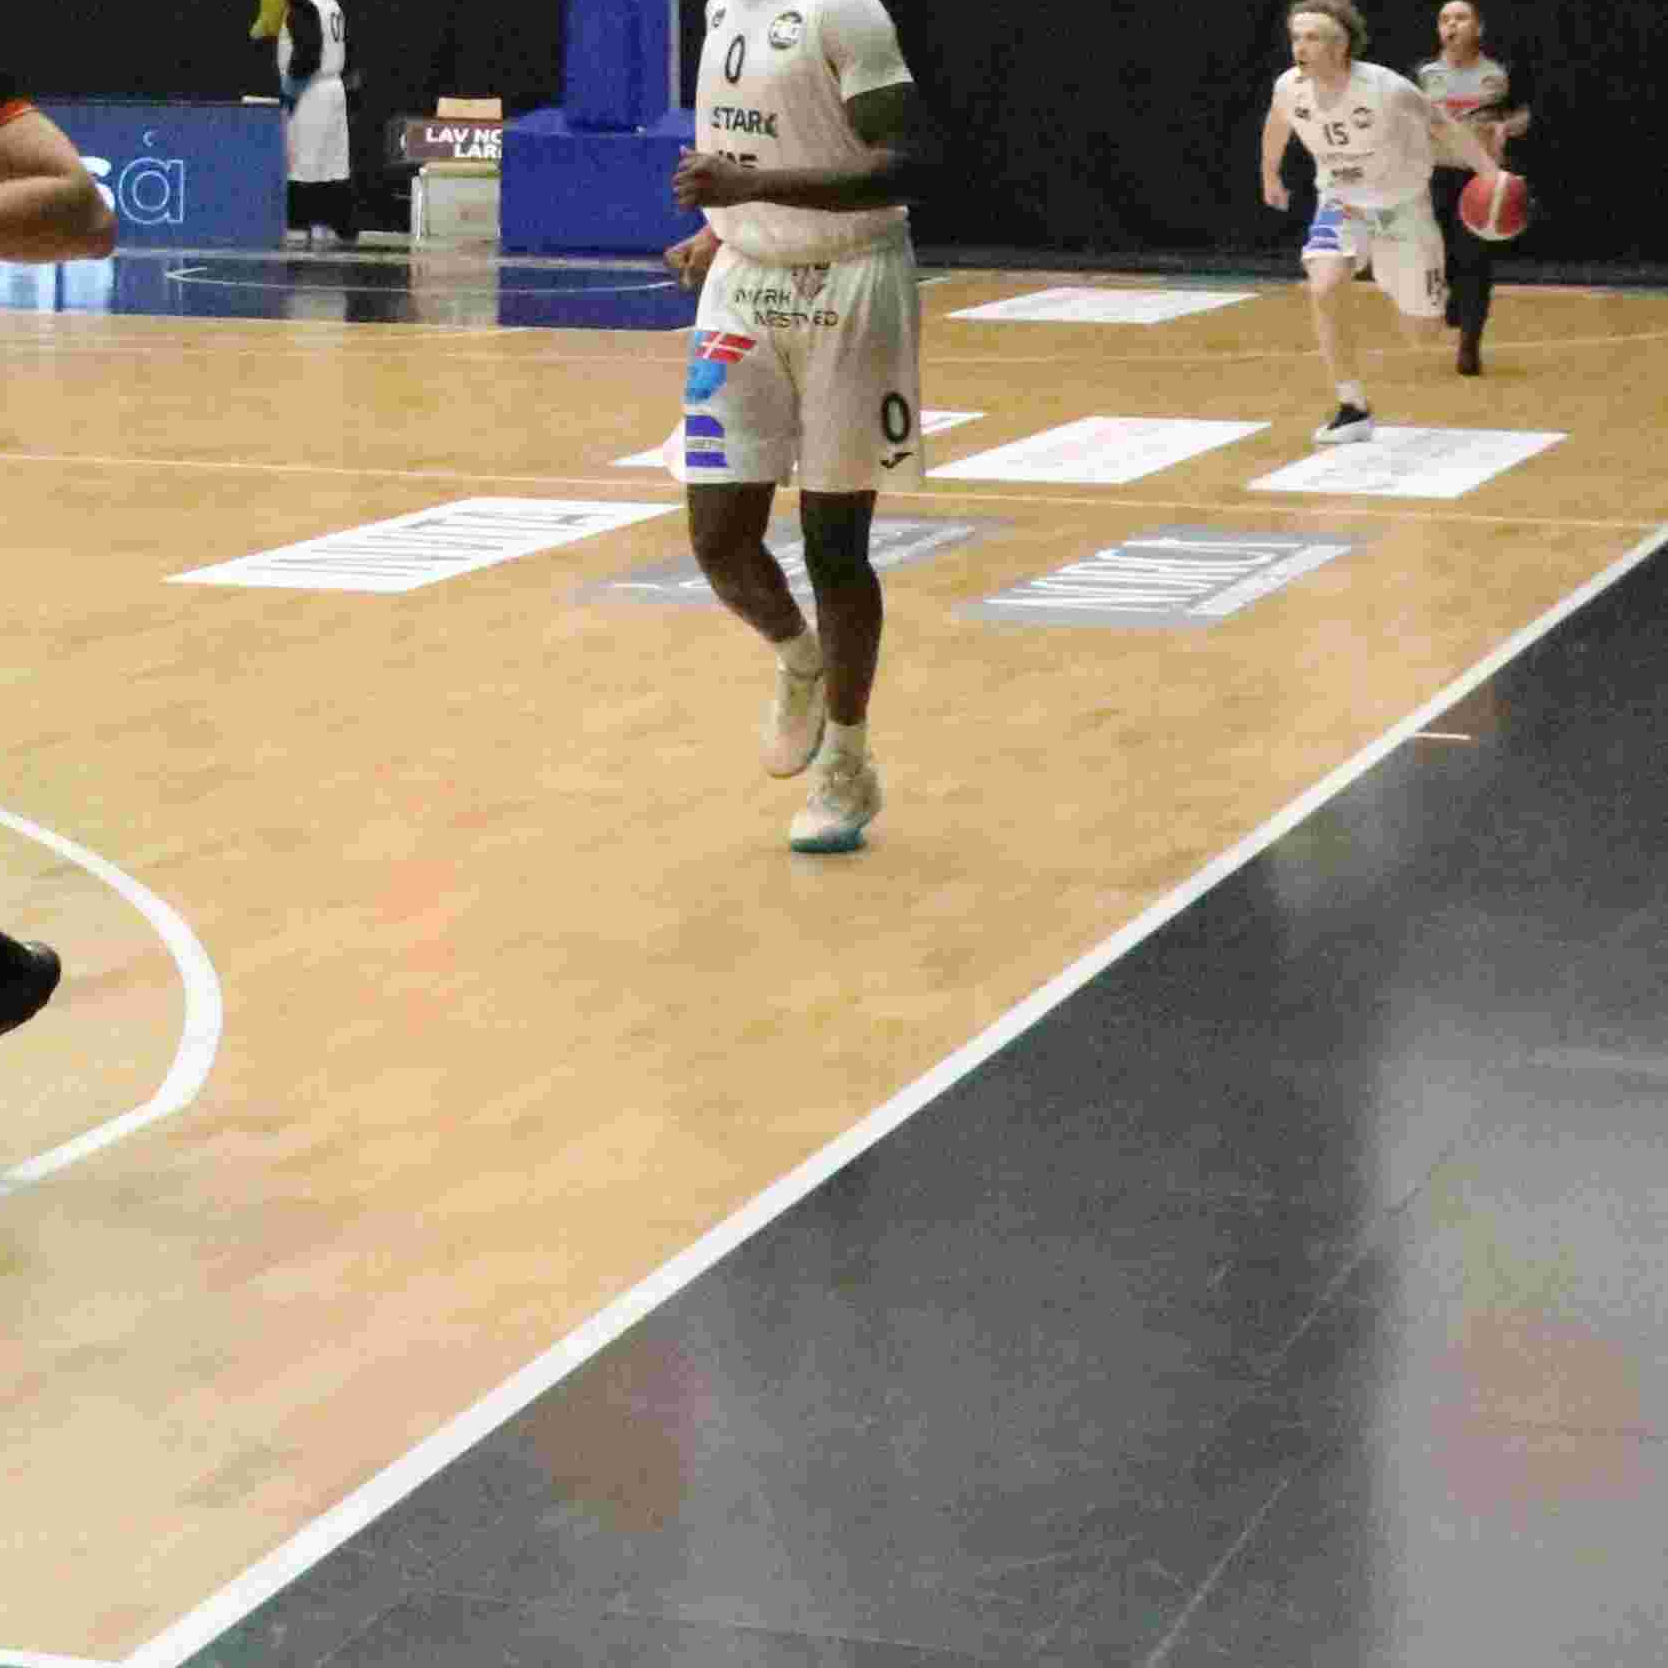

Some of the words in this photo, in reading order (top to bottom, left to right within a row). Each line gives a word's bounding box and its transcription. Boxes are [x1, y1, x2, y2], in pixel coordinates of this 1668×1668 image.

[724, 33, 746, 85] 0
[425, 126, 470, 144] LAV
[713, 106, 778, 138] STARK
[1323, 122, 1351, 147] 15
[879, 390, 912, 446] 0
